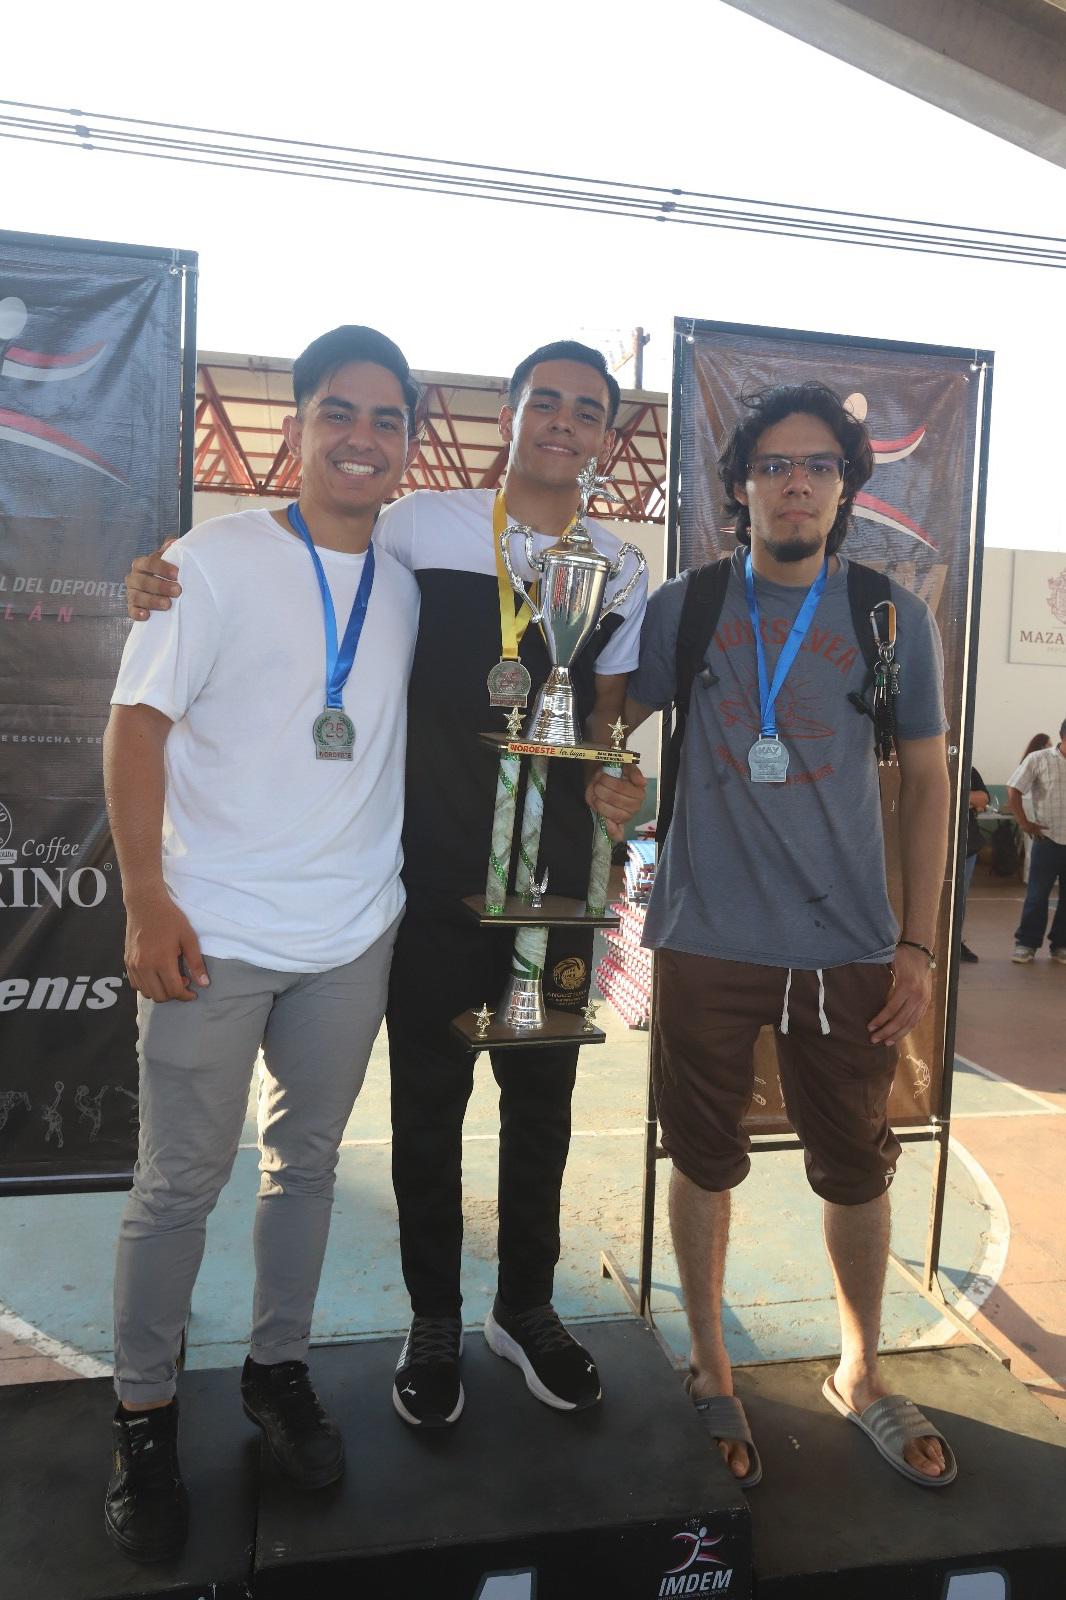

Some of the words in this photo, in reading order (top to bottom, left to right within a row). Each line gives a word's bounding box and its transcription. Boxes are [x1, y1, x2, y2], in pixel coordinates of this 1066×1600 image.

[14, 577, 44, 593] DEL
[49, 578, 126, 598] DEPORTE
[12, 735, 71, 744] ESCUCHA
[325, 722, 345, 739] 25
[510, 744, 556, 755] NOROESTE
[21, 836, 80, 864] Coffee
[658, 1569, 733, 1597] IMDEM
